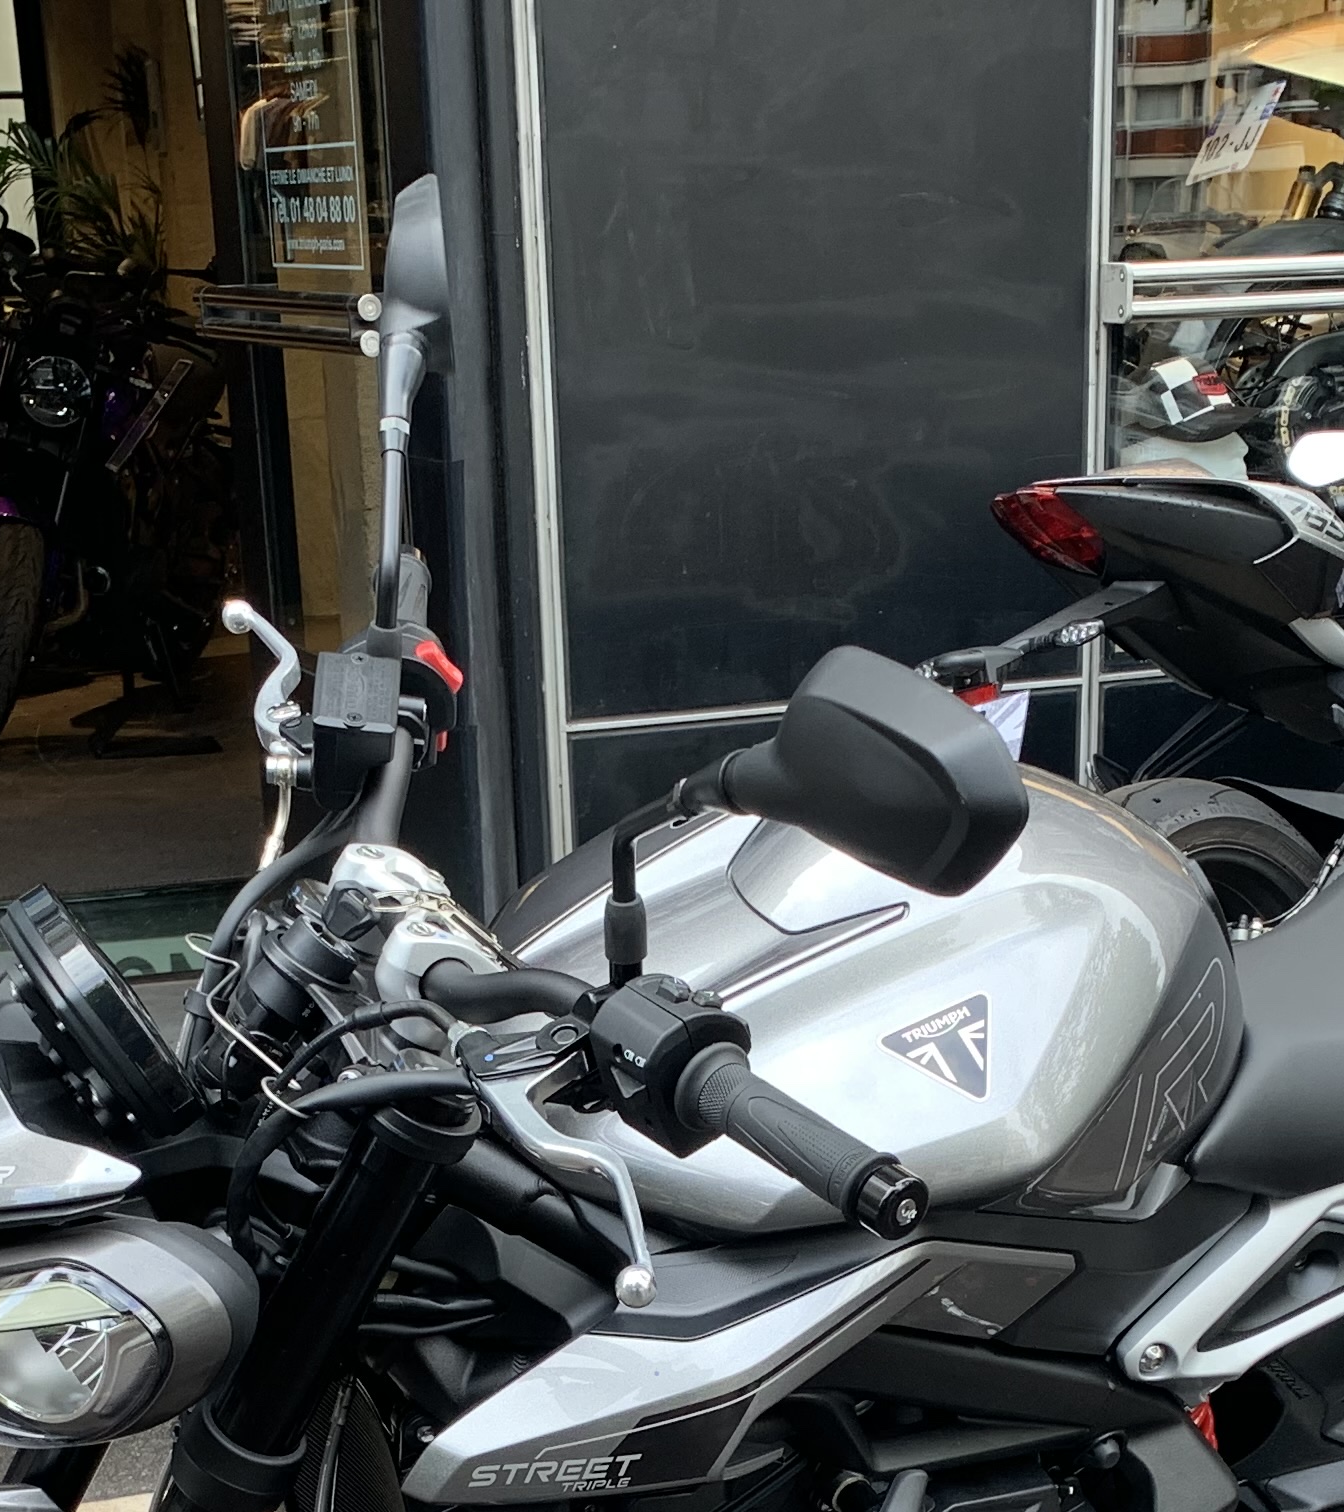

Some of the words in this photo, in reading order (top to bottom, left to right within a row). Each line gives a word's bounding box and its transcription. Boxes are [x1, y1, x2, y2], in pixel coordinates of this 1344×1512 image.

[290, 80, 318, 102] SAMEDI
[290, 197, 301, 223] 01
[303, 196, 315, 223] 48
[316, 196, 328, 223] 04
[329, 195, 342, 223] 88
[343, 195, 356, 223] 00
[901, 1006, 971, 1043] TRIUMPH
[468, 1453, 643, 1488] STREET
[562, 1477, 632, 1493] TRIPLE
